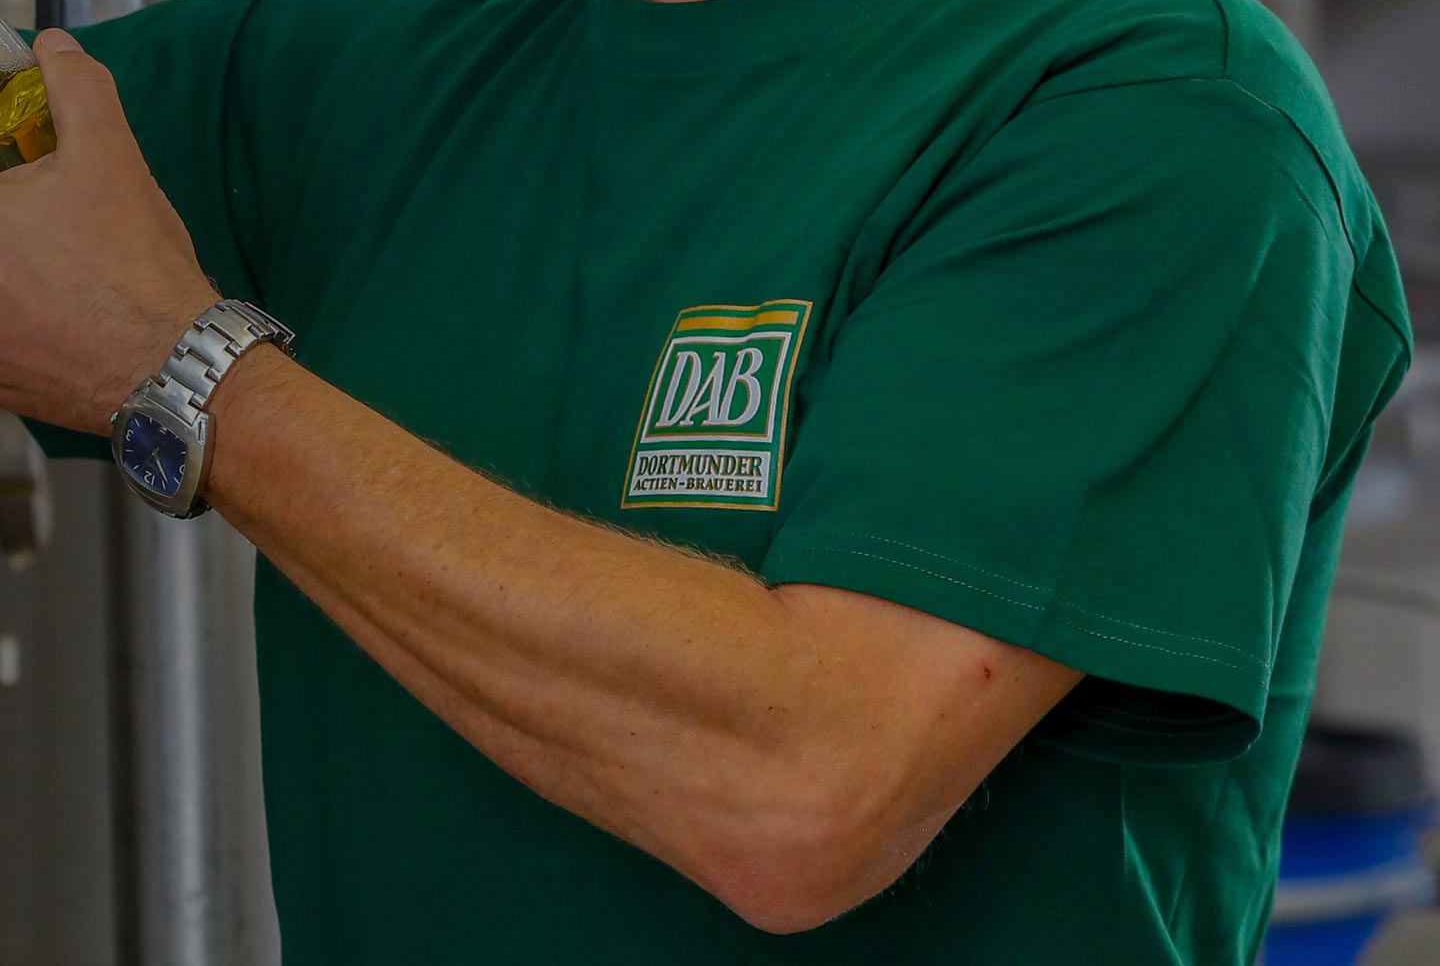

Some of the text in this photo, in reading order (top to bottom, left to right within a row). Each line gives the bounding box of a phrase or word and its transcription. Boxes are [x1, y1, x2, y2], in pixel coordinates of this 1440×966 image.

[654, 346, 765, 428] DAB
[125, 429, 134, 442] 3
[636, 453, 763, 478] DORTMUNDER
[633, 477, 763, 493] ACTIEN-BRAUEREI
